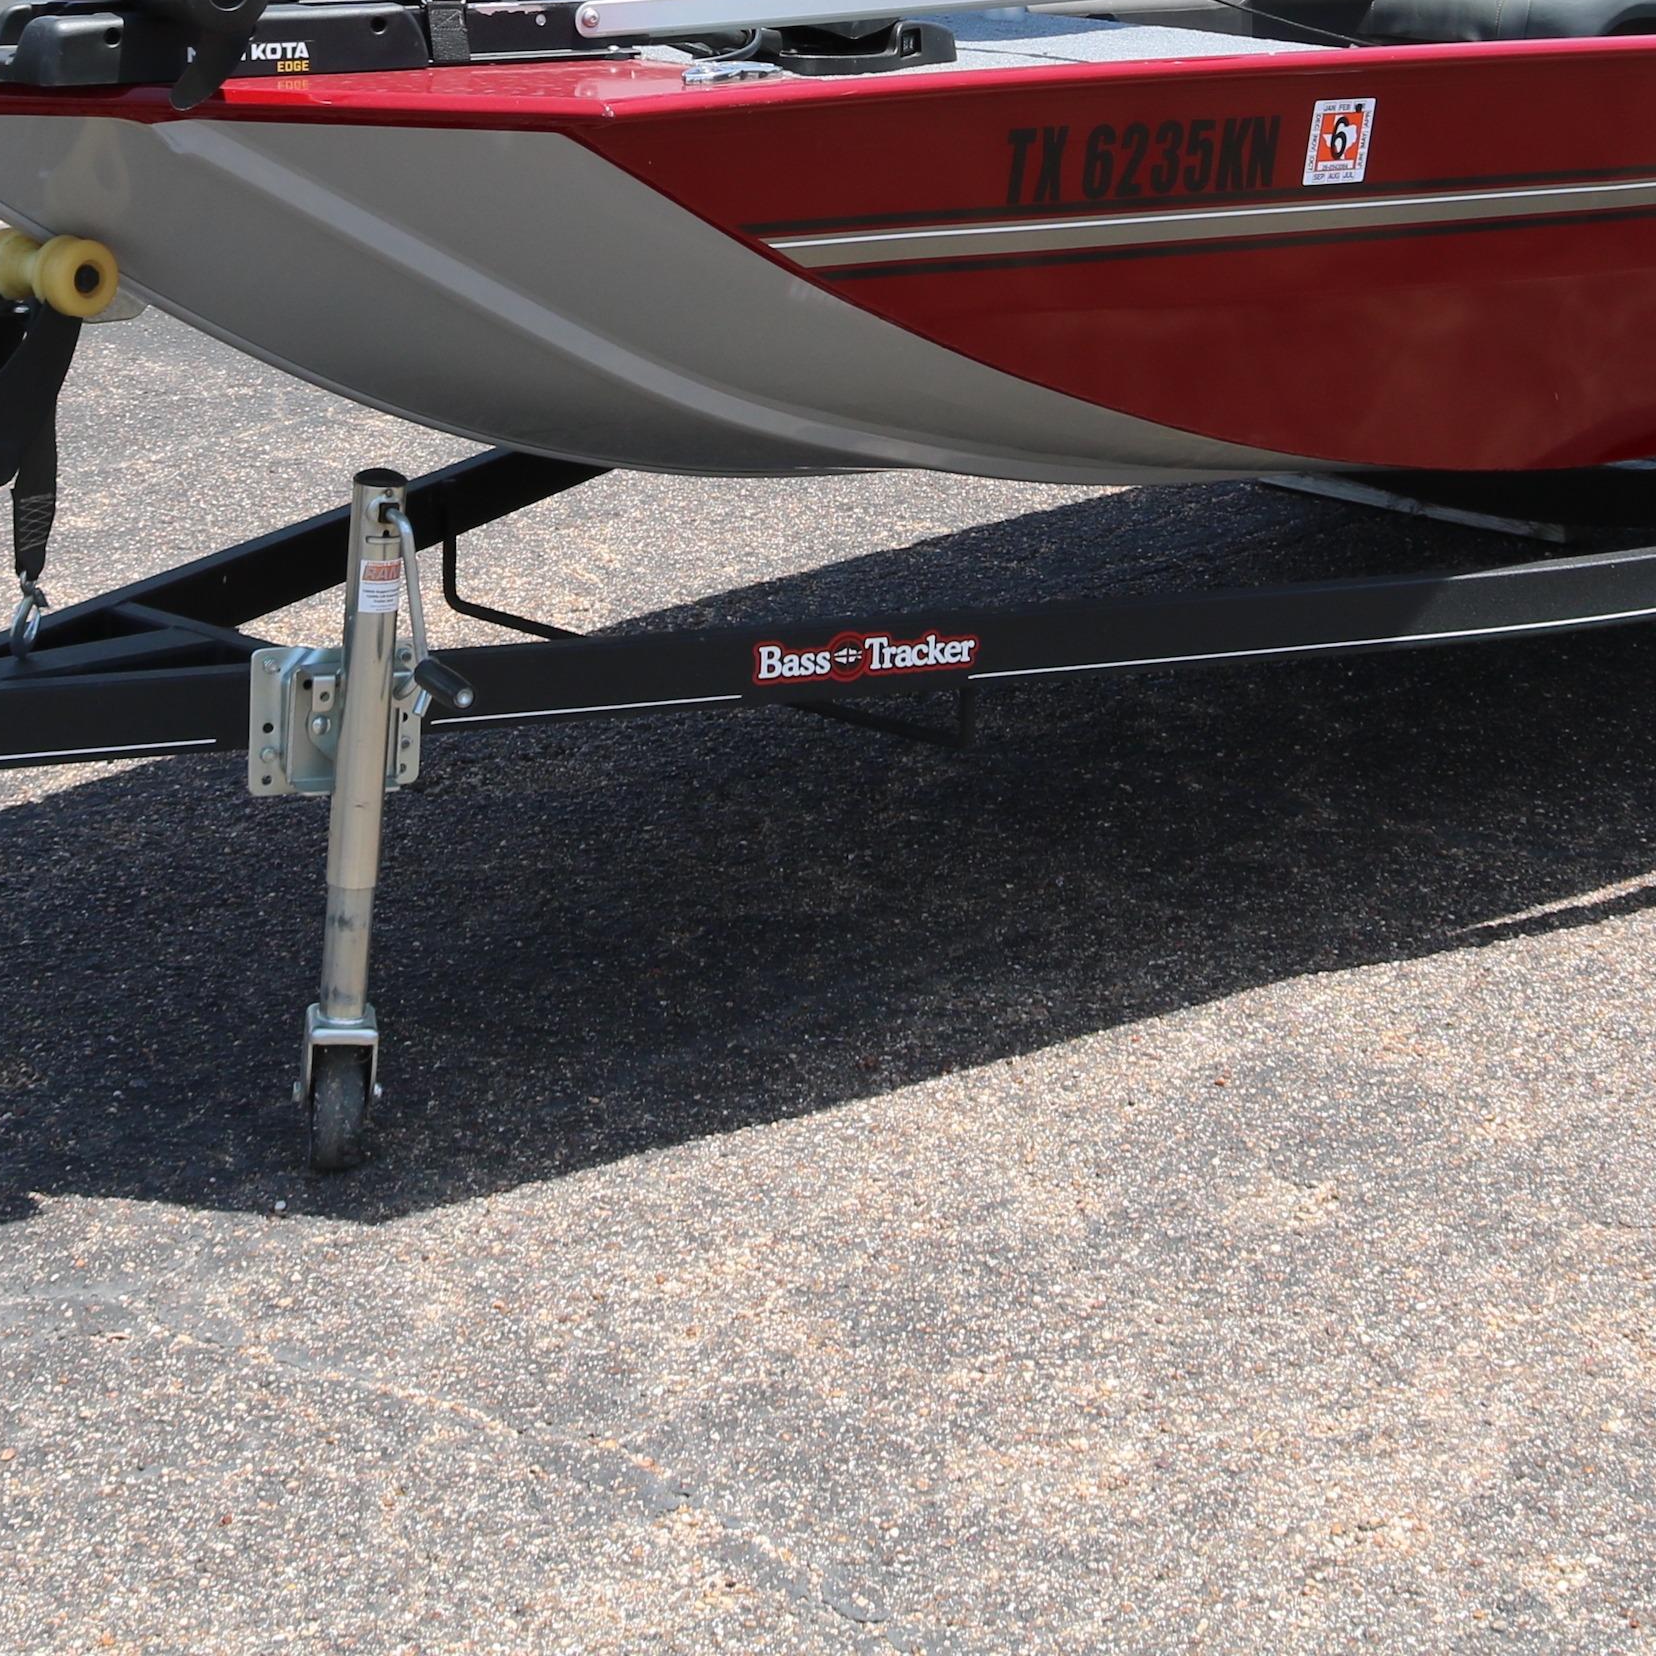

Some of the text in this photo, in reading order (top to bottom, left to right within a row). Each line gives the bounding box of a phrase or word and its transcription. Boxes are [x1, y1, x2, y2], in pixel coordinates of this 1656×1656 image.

[251, 42, 310, 60] KOTA
[277, 60, 310, 73] EDGE
[1006, 115, 1281, 204] TX 6235KN
[1330, 117, 1349, 161] 6
[758, 635, 975, 680] Bass Tracker
